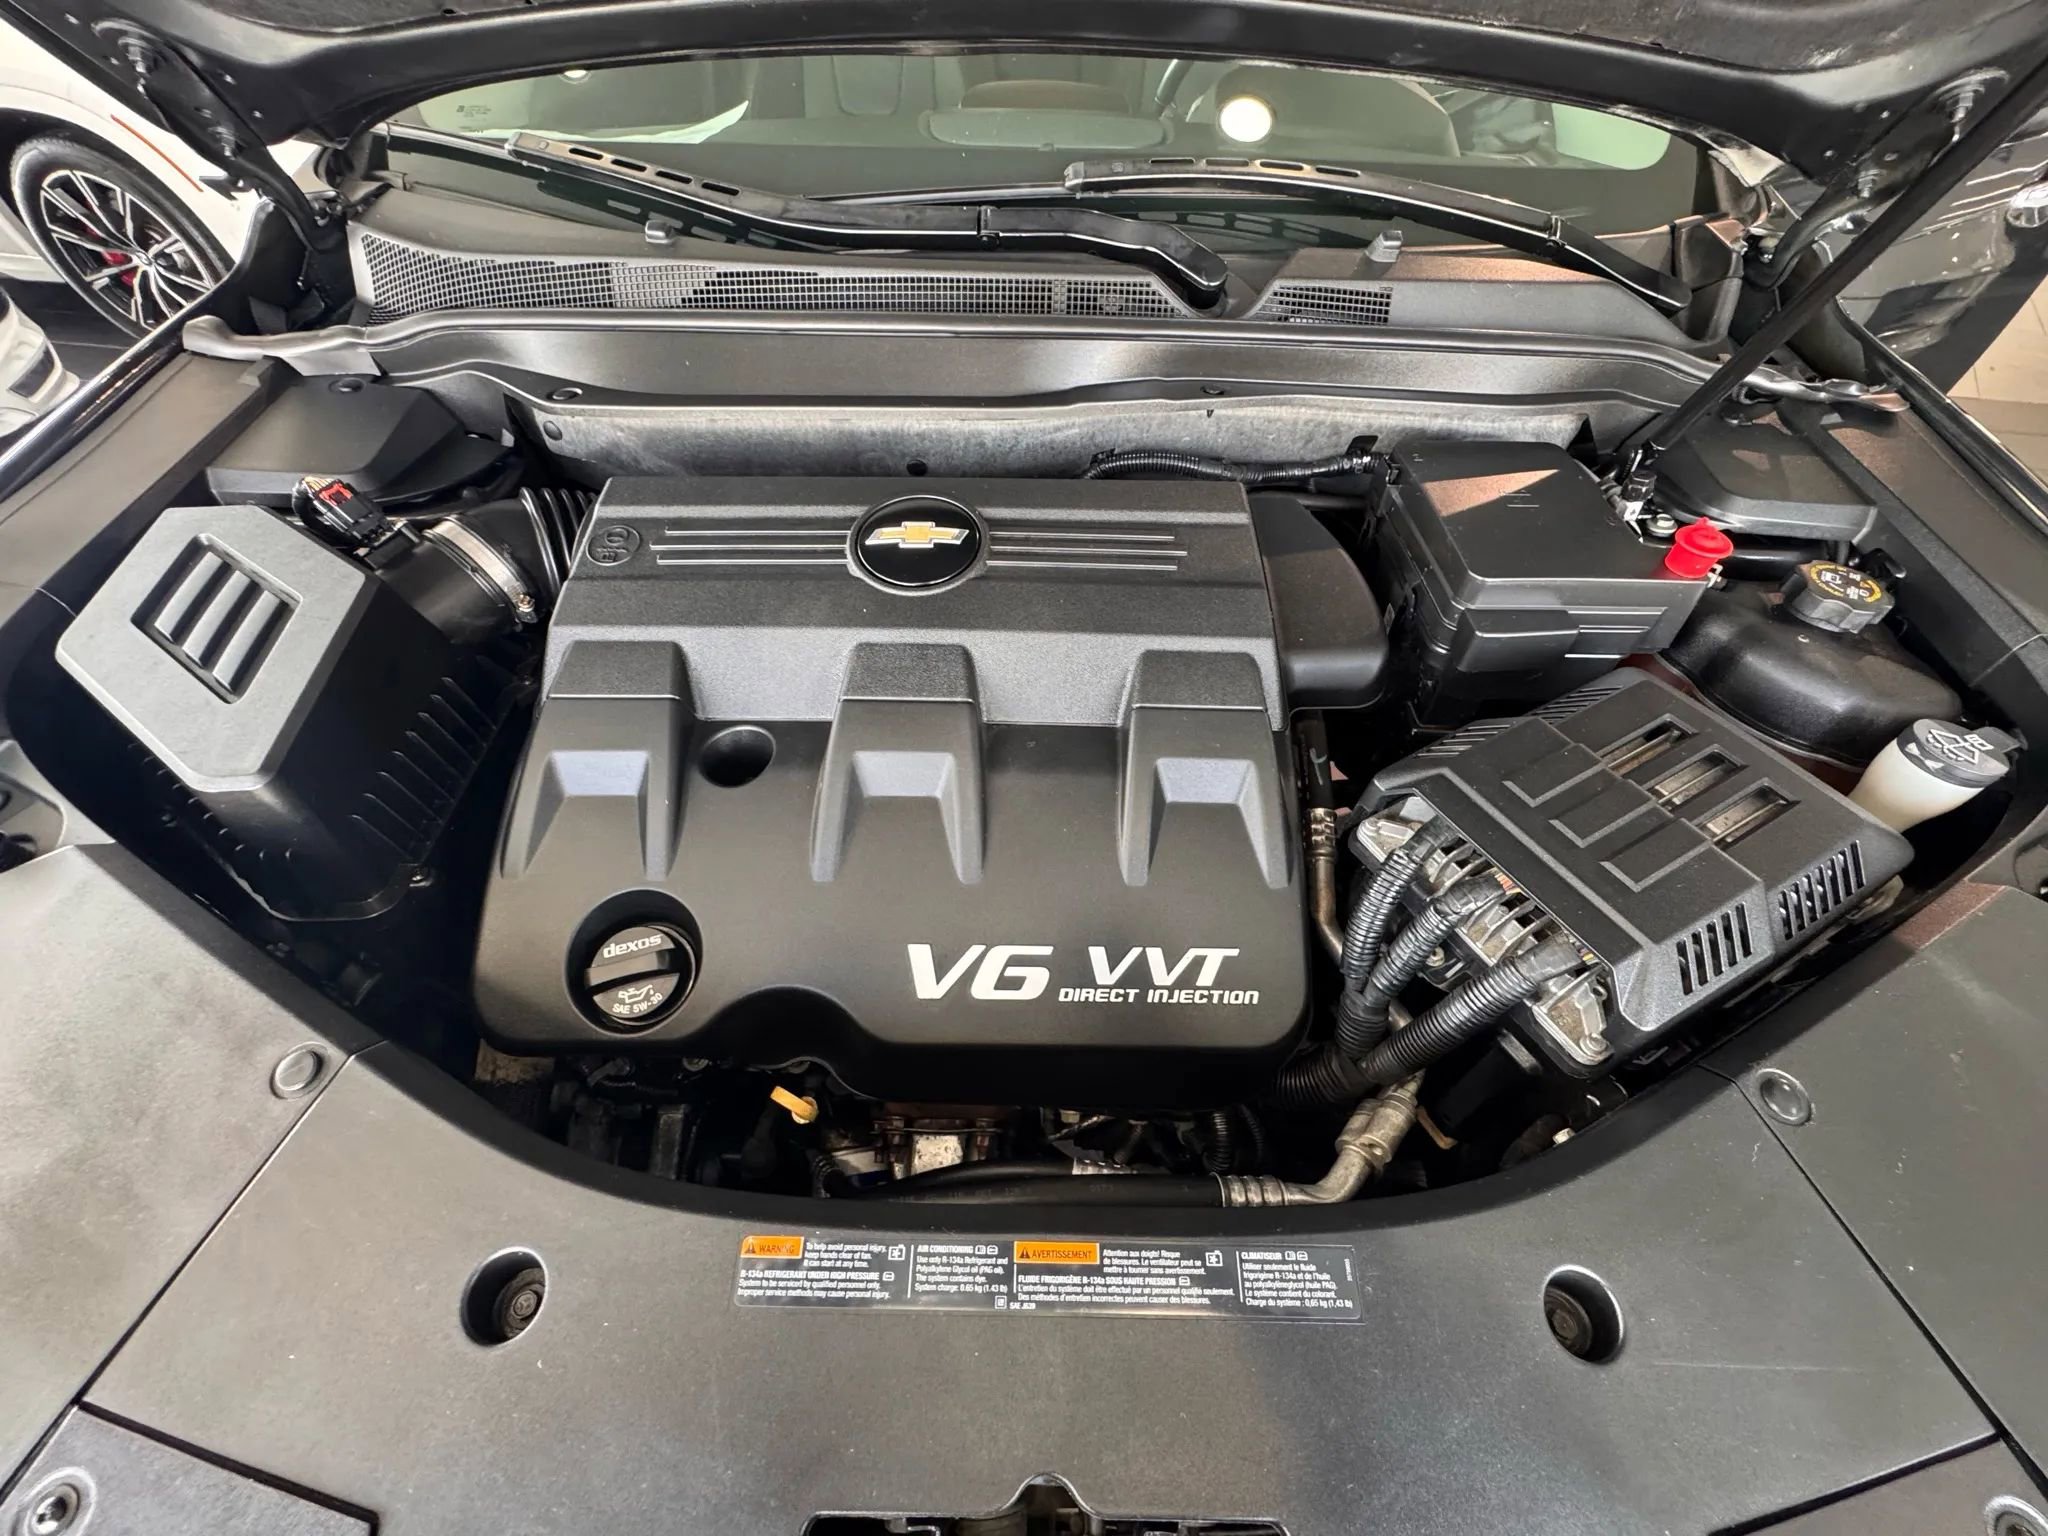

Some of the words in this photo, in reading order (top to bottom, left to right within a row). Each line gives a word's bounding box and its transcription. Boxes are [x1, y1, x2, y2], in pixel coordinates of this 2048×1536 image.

[603, 934, 664, 958] dexos
[907, 943, 1054, 1000] V6
[1088, 946, 1240, 986] VVT
[1058, 987, 1139, 1003] DIRECT
[1147, 988, 1259, 1005] INJECTION
[612, 1003, 630, 1014] SAE
[633, 993, 663, 1013] 5W-30
[759, 1244, 795, 1254] WARNING
[814, 1243, 826, 1252] help
[844, 1244, 868, 1252] personal
[930, 1245, 973, 1253] CONDITIONING
[805, 1252, 819, 1260] keep
[1032, 1250, 1093, 1259] AVERTISSEMENT
[1103, 1249, 1128, 1257] Attention
[1161, 1250, 1180, 1258] Risque
[1241, 1251, 1282, 1260] CLIMATISEUR
[917, 1255, 928, 1263] Use
[929, 1256, 941, 1264] only
[942, 1256, 963, 1264] R-134a
[965, 1256, 996, 1265] Refrigerant
[1180, 1259, 1193, 1267] peut
[916, 1264, 952, 1274] Polyalkylene
[953, 1265, 970, 1274] Glycol
[980, 1266, 993, 1274] (PAG
[1128, 1266, 1149, 1274] tourner
[1263, 1263, 1293, 1271] seulement
[1294, 1263, 1299, 1271] le
[1300, 1263, 1316, 1271] fluide
[740, 1270, 763, 1278] R-134a
[764, 1270, 807, 1279] REFRIGERANT
[808, 1271, 829, 1279] UNDER
[830, 1271, 846, 1279] HIGH
[847, 1272, 879, 1280] PRESSURE
[928, 1275, 948, 1283] system
[1275, 1272, 1296, 1280] R-134a
[739, 1279, 761, 1288] System
[778, 1280, 803, 1288] serviced
[804, 1280, 811, 1289] by
[812, 1280, 837, 1289] qualified
[838, 1281, 866, 1290] personnel
[1018, 1275, 1040, 1283] FLUIDE
[1083, 1276, 1105, 1284] R-134a
[1106, 1277, 1122, 1285] SOUS
[1124, 1277, 1144, 1285] HAUTE
[1145, 1277, 1176, 1286] PRESSION
[915, 1283, 936, 1292] System
[975, 1284, 982, 1293] kg
[1152, 1287, 1180, 1295] personnel
[737, 1288, 764, 1297] Improper
[765, 1288, 786, 1296] service
[787, 1289, 813, 1297] methods
[814, 1290, 827, 1299] may
[846, 1290, 871, 1299] personal
[1018, 1293, 1030, 1301] Des
[1279, 1290, 1302, 1298] contient
[1303, 1290, 1311, 1298] du
[1010, 1302, 1021, 1310] SAE
[1246, 1298, 1266, 1307] Charge
[1320, 1299, 1328, 1308] kg
